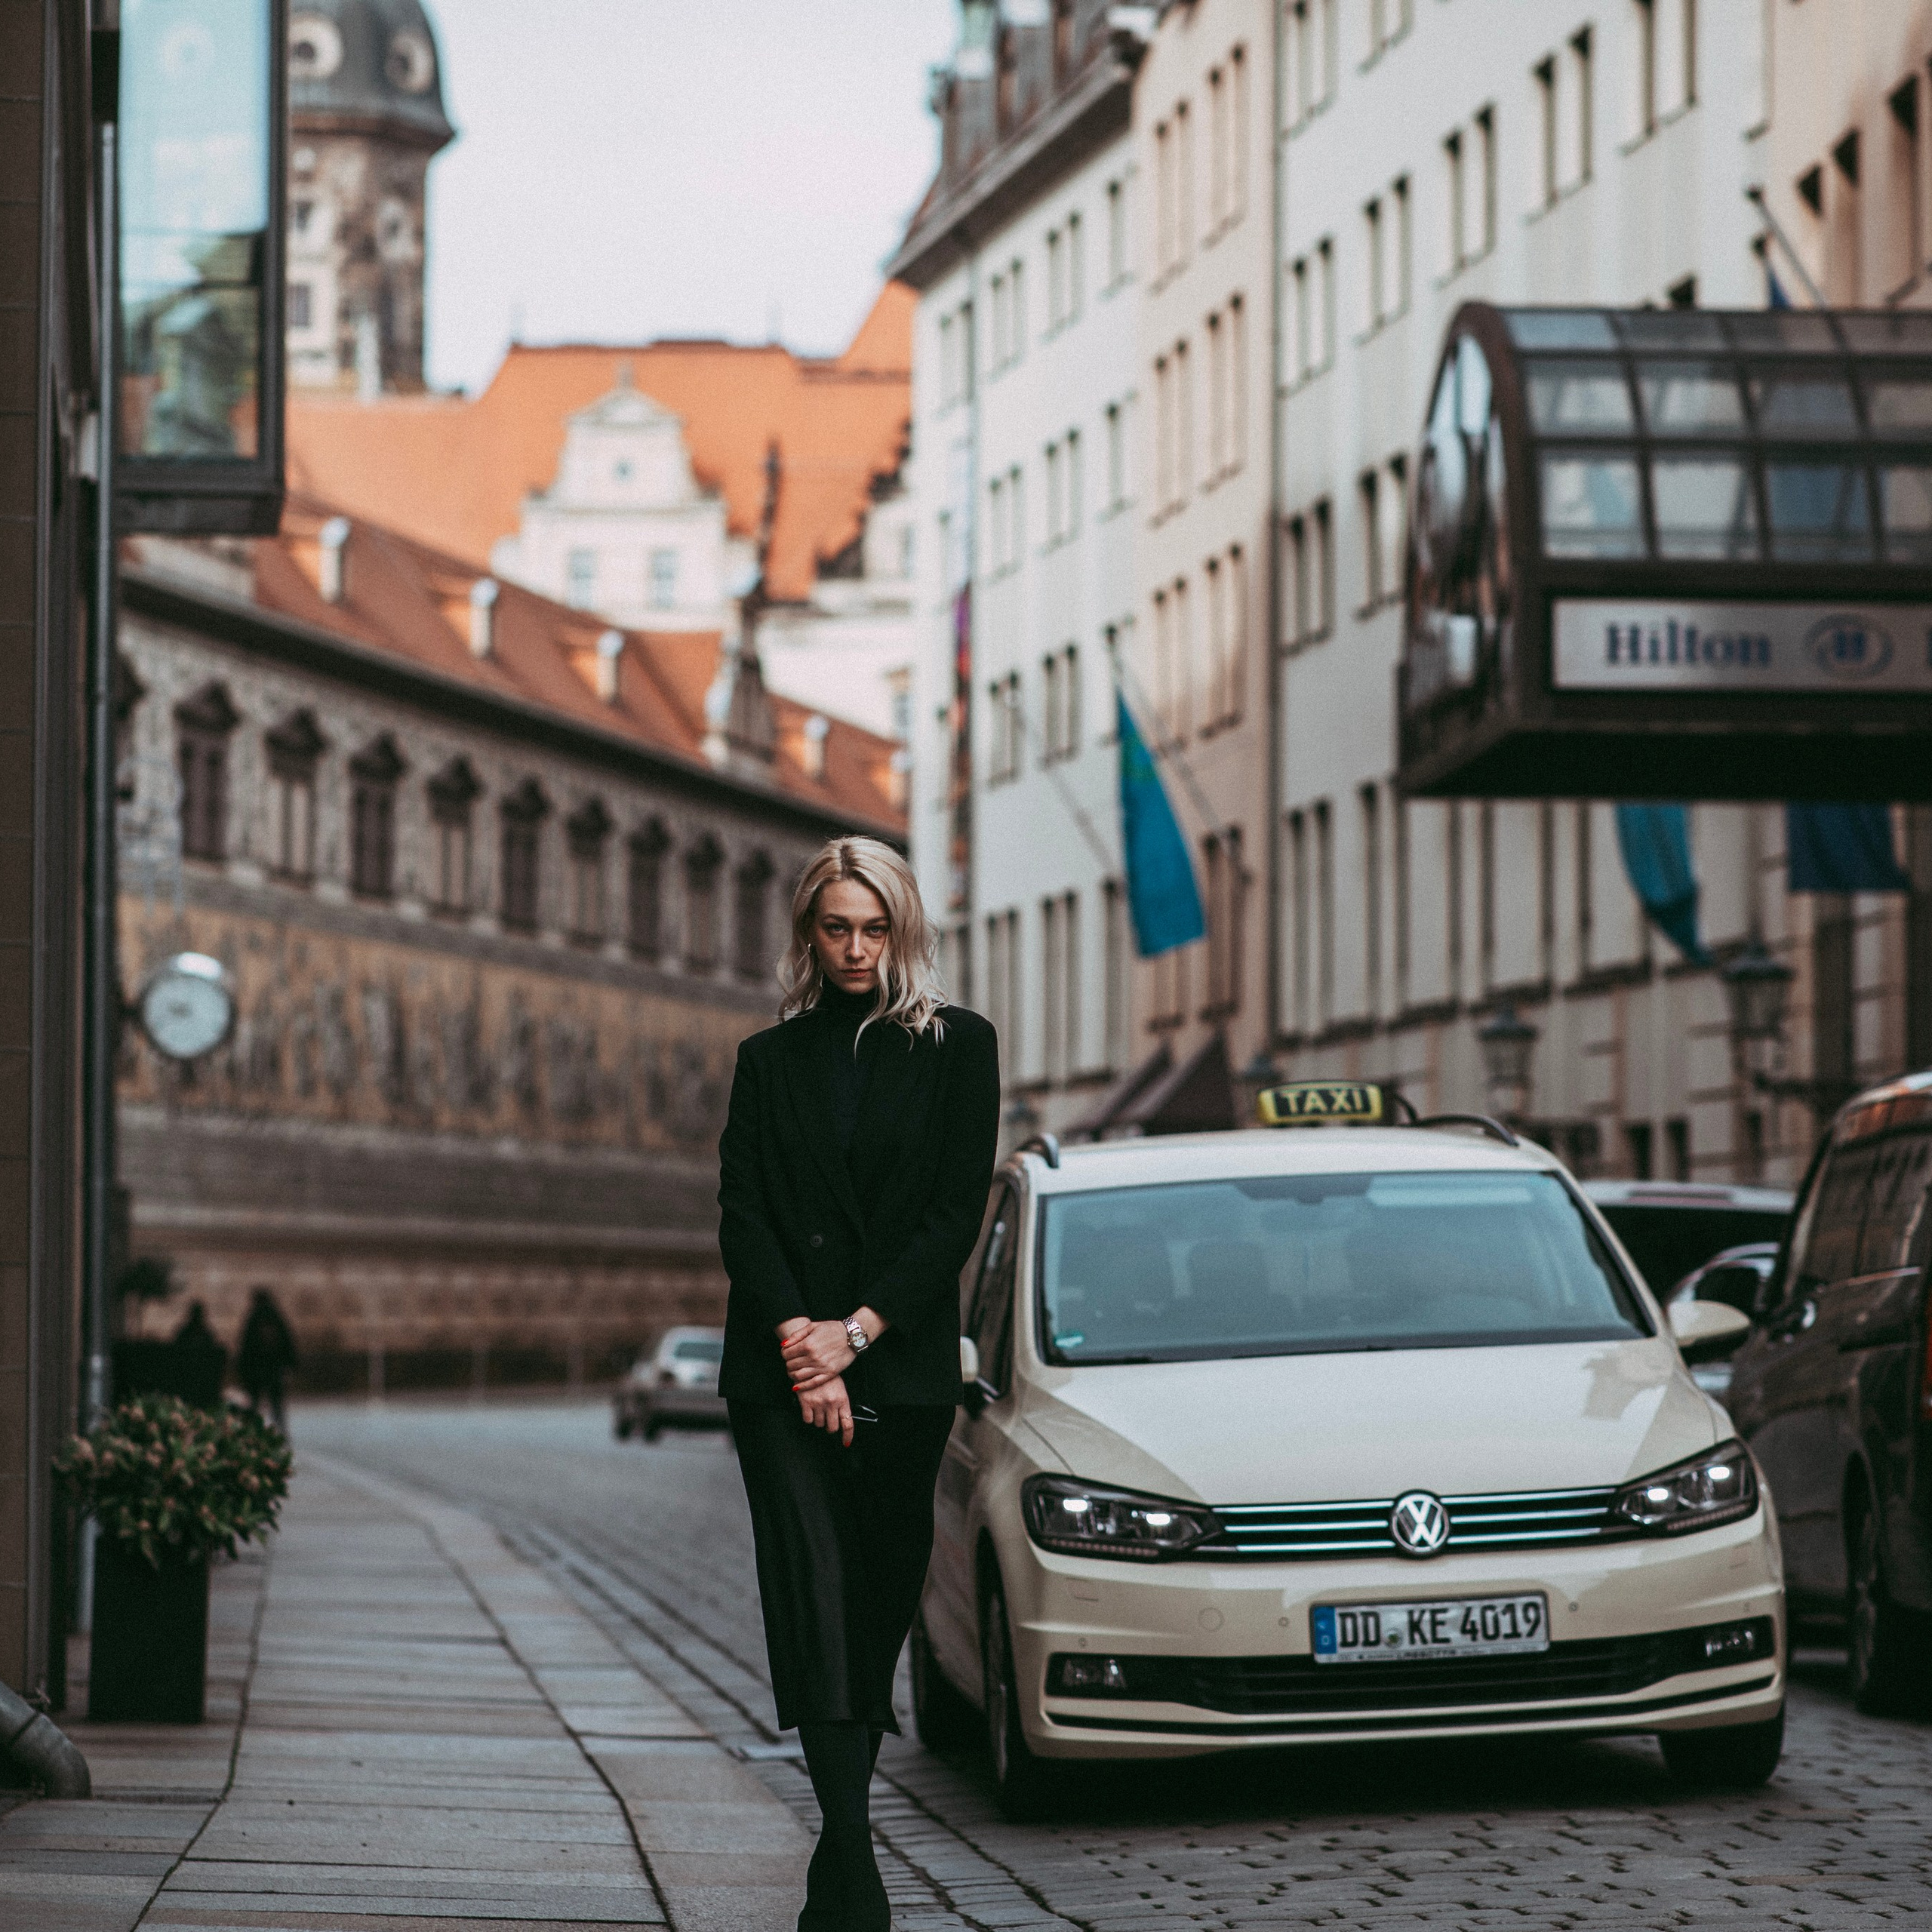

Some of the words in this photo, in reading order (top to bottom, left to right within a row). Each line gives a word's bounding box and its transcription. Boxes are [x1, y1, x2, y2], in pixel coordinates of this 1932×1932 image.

[1607, 617, 1770, 666] Hilton
[1283, 1090, 1362, 1112] TAXI
[1395, 1497, 1442, 1546] VW
[1338, 1611, 1381, 1647] DD
[1407, 1607, 1451, 1644] KE
[1460, 1601, 1541, 1641] 4019
